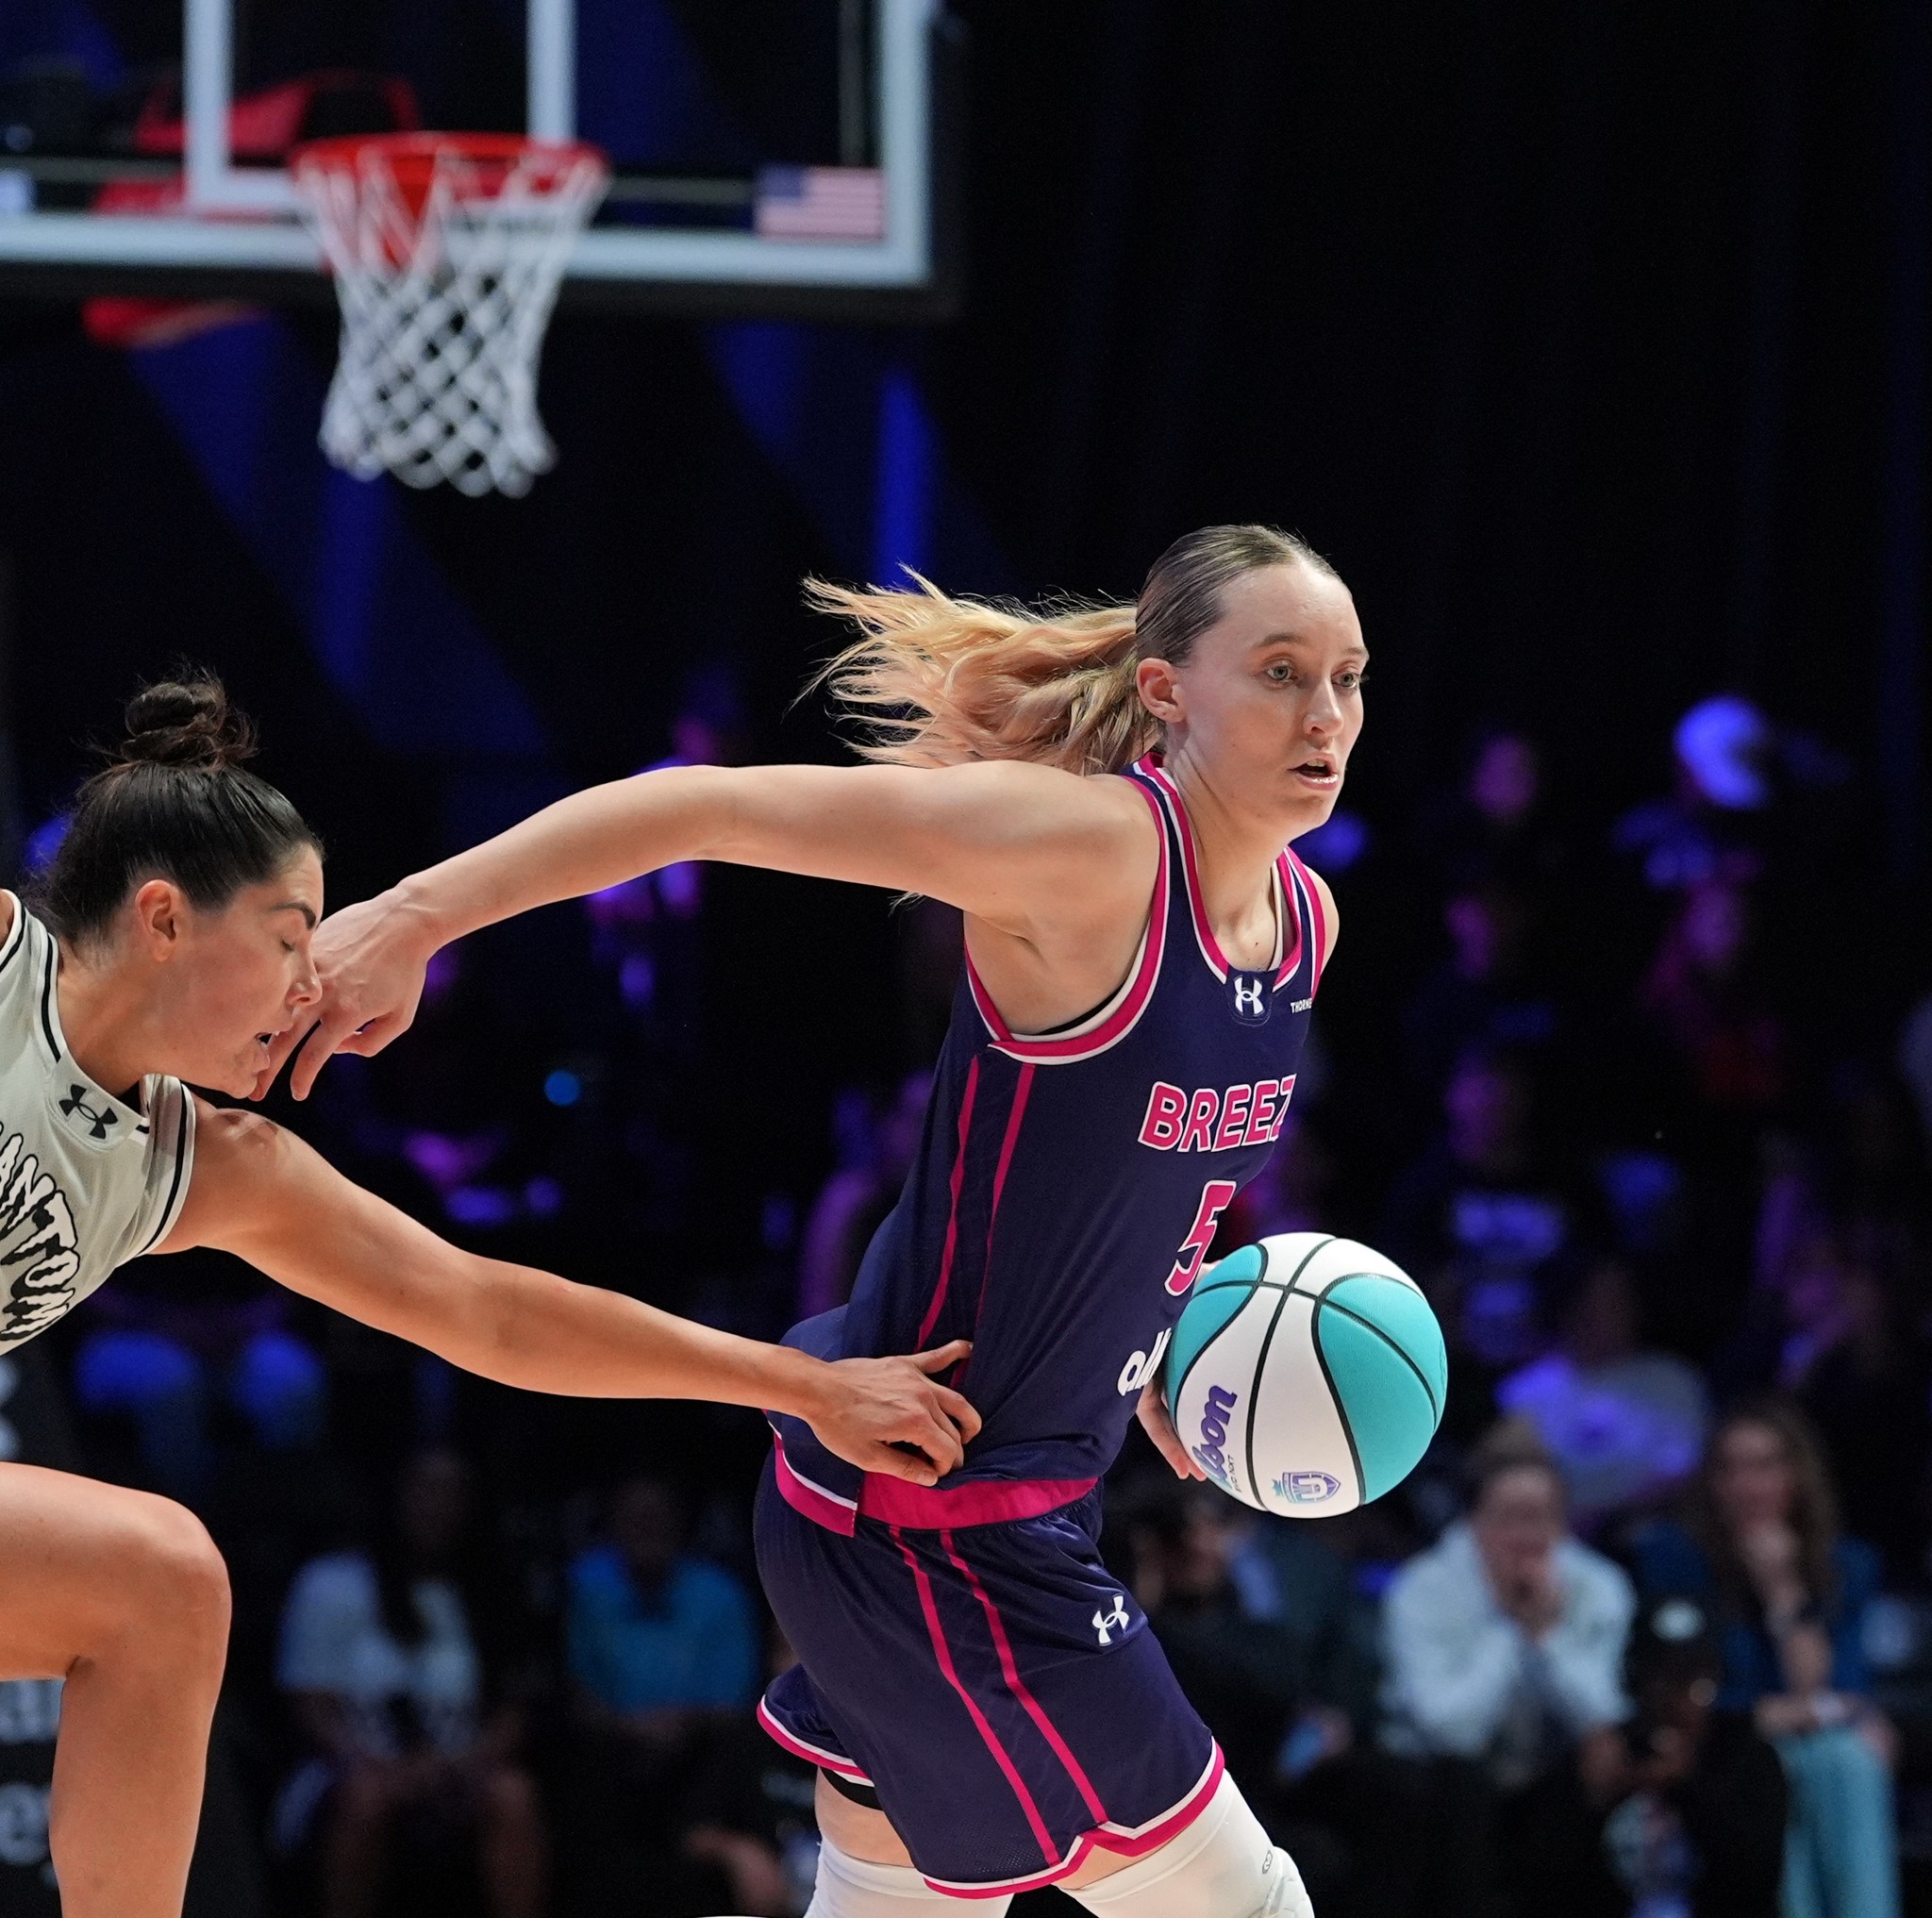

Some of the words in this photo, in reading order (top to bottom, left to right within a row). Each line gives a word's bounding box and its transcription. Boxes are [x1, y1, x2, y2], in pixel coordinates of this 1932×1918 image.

[0, 1121, 80, 1341] ANTOM
[1164, 1180, 1237, 1296] 5
[1192, 1385, 1238, 1491] lson
